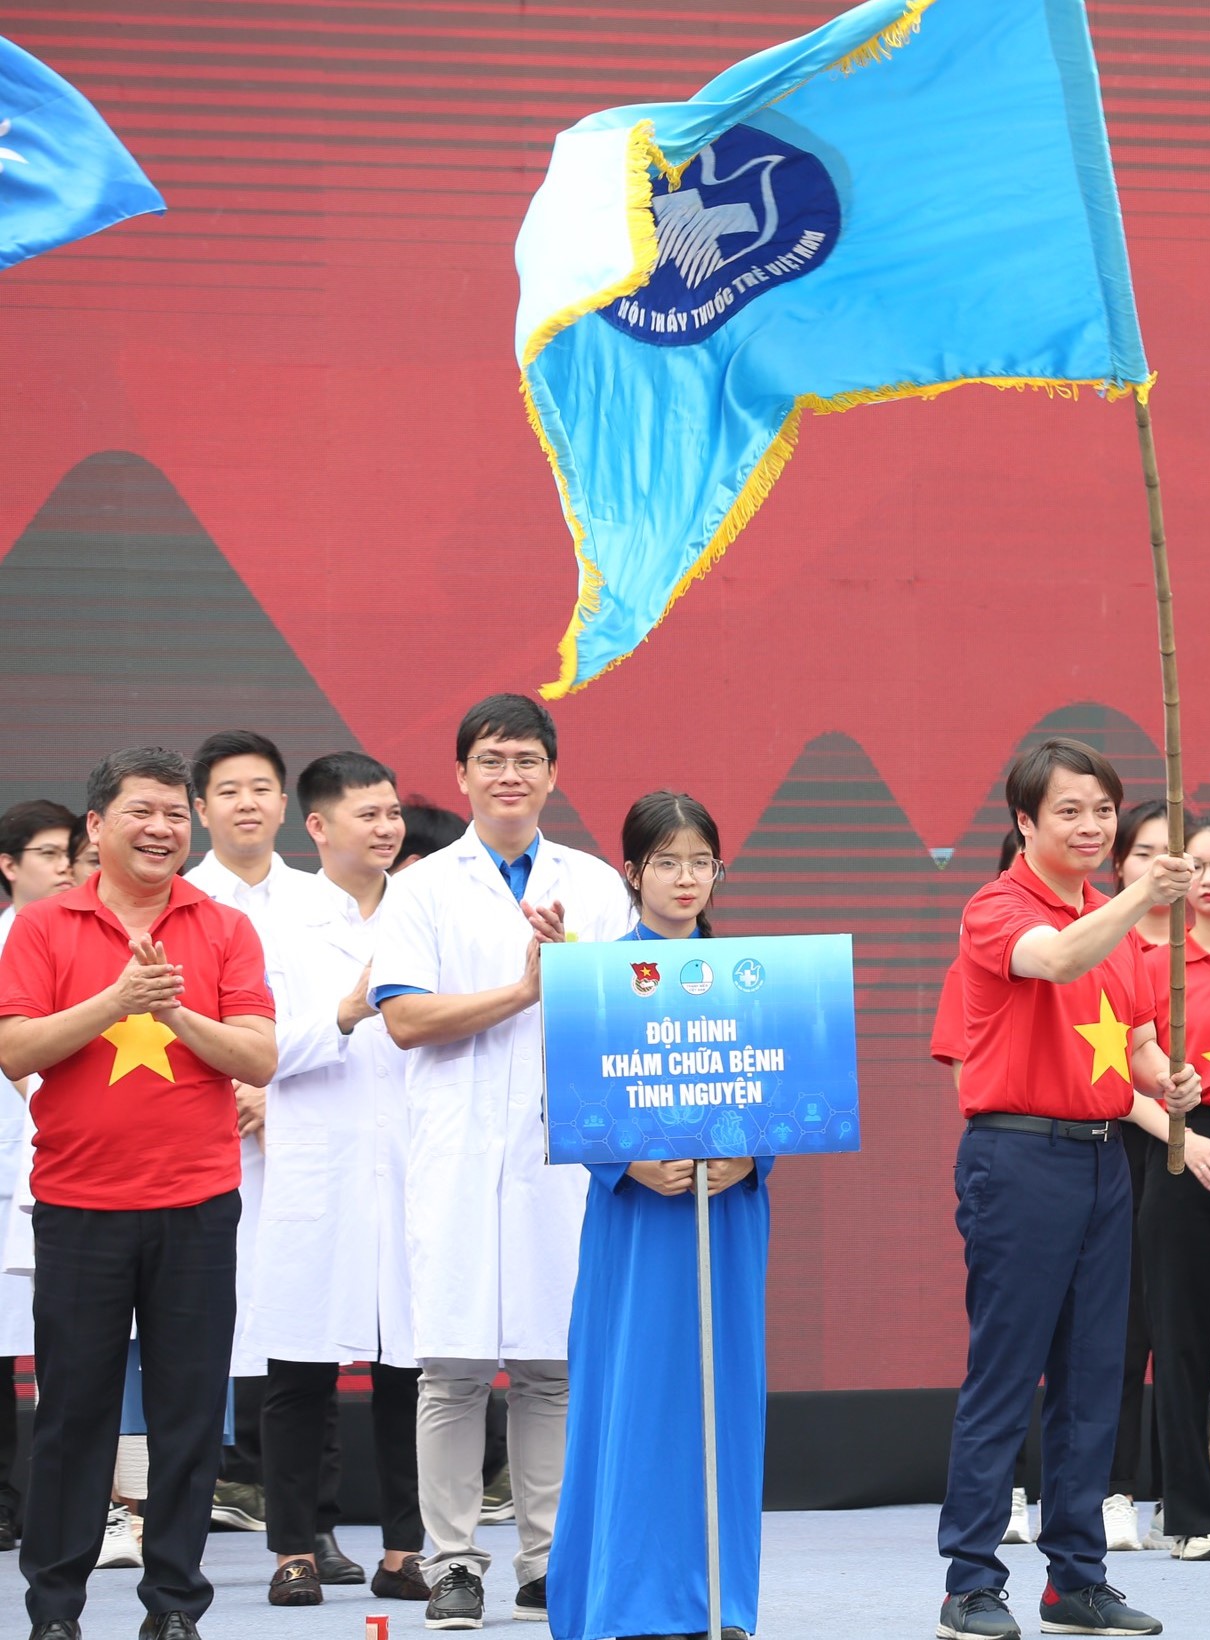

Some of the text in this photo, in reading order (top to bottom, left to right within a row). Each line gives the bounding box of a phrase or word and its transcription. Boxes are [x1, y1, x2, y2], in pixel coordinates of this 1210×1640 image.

[617, 297, 646, 327] HỘI
[690, 287, 735, 329] THUỐC
[731, 265, 770, 294] TRẺ
[792, 229, 826, 259] NAM
[646, 1015, 737, 1049] ĐỘI HÌNH
[602, 1045, 785, 1078] KHÁM CHỮA BỆNH
[626, 1077, 763, 1109] TÌNH NGUYỆN
